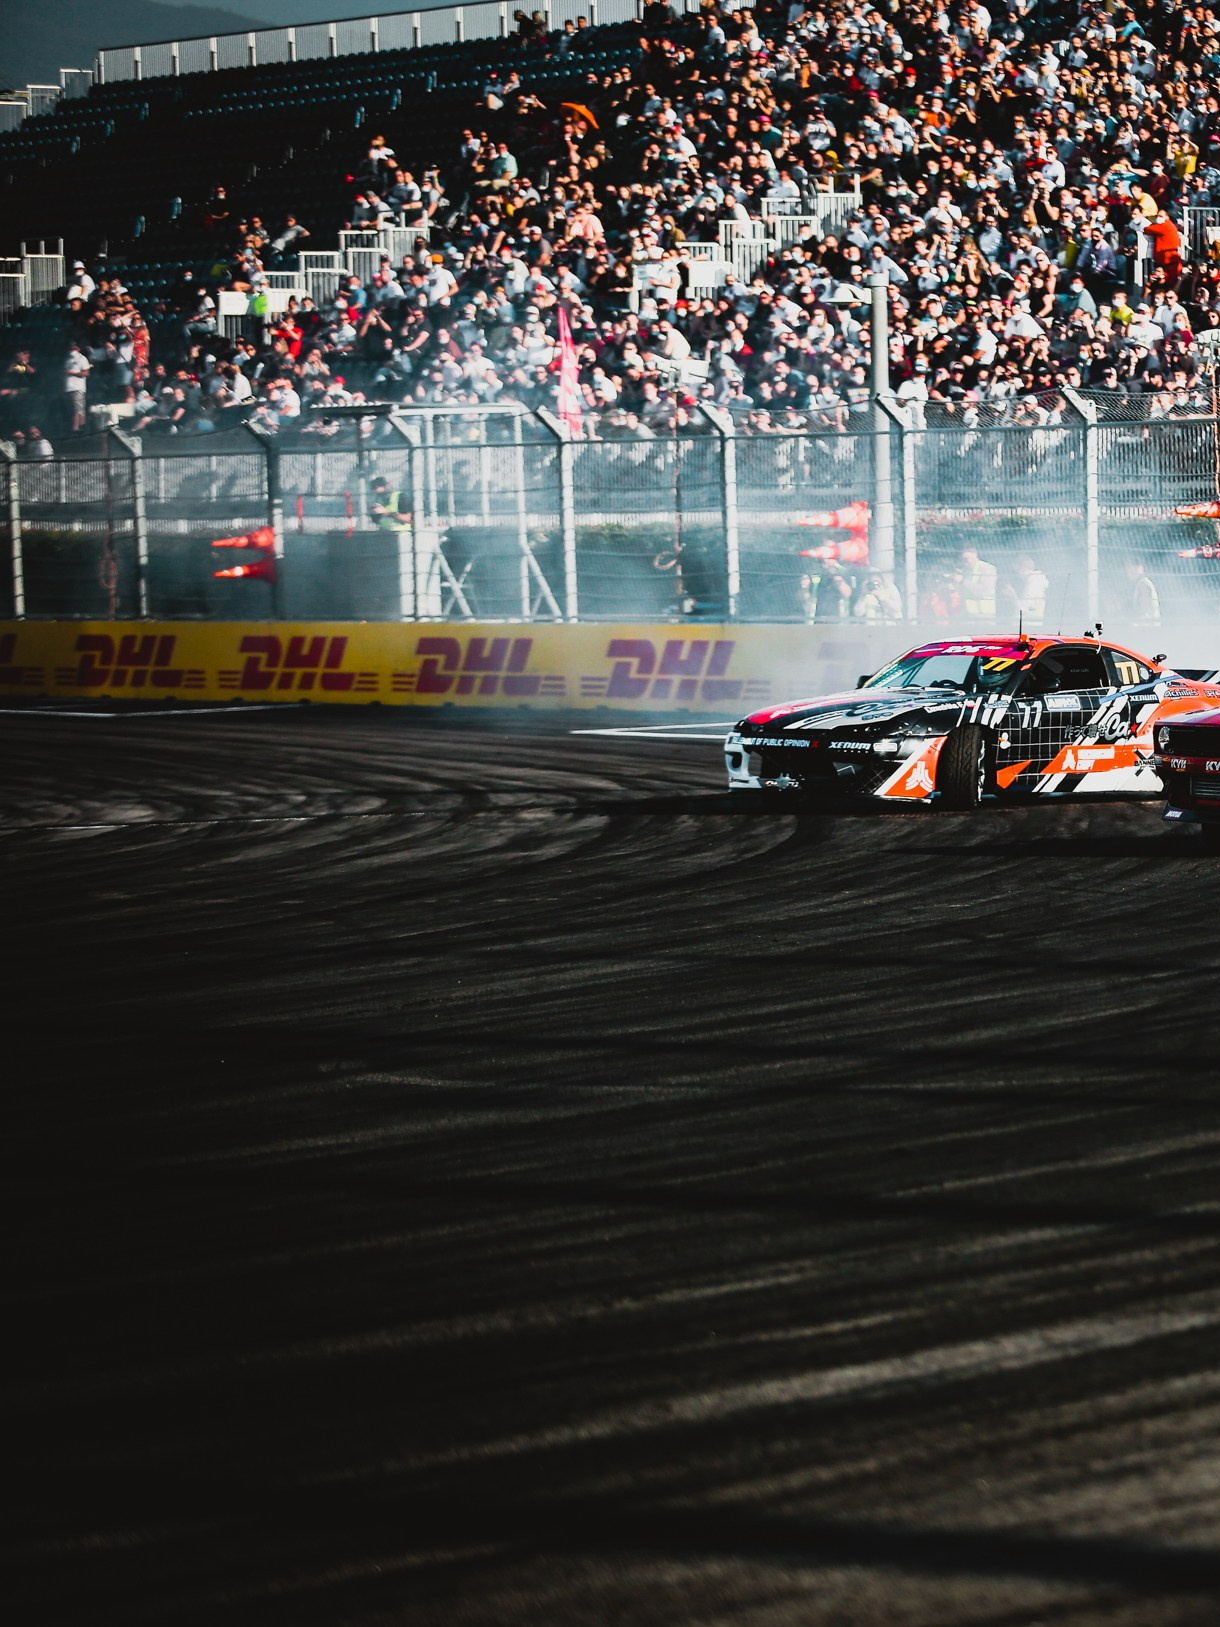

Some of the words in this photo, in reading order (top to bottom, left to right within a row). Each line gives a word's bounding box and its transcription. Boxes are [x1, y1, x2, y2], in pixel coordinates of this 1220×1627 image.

[75, 635, 186, 688] DHL
[239, 635, 356, 691] DHL
[415, 637, 542, 695] DHL
[606, 639, 744, 700] DHL
[981, 656, 1017, 671] 77
[1114, 660, 1140, 685] 77
[763, 738, 784, 746] PUBLIC
[784, 739, 811, 748] OPINION
[1170, 758, 1187, 769] KYB
